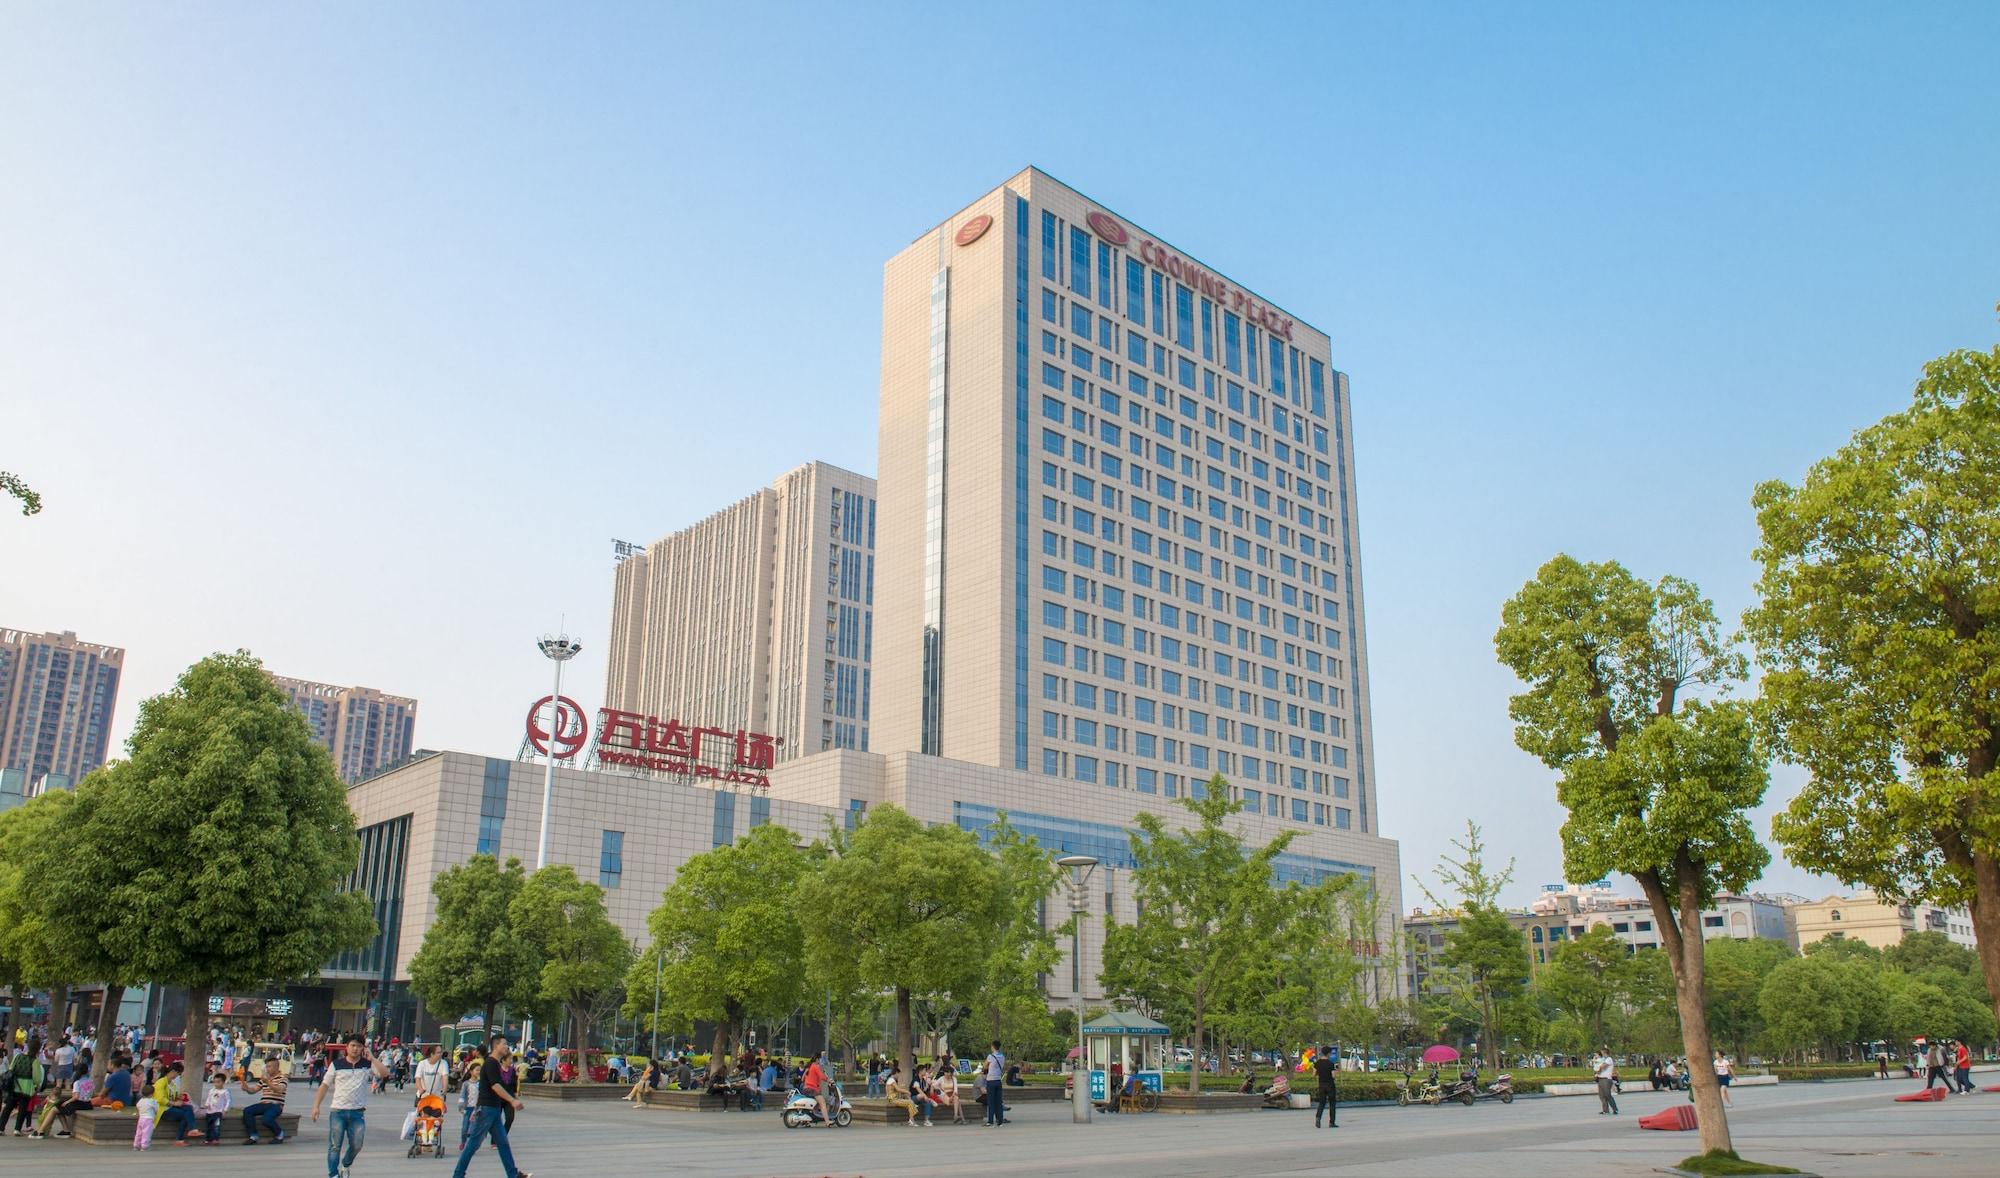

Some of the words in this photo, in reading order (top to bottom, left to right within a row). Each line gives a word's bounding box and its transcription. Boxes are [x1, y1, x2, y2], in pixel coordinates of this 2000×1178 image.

[1140, 240, 1226, 304] CROWNE
[1234, 289, 1294, 342] PLAZA
[598, 750, 689, 774] WANDA
[694, 765, 771, 787] PLAZA
[600, 708, 774, 769] 万达广场
